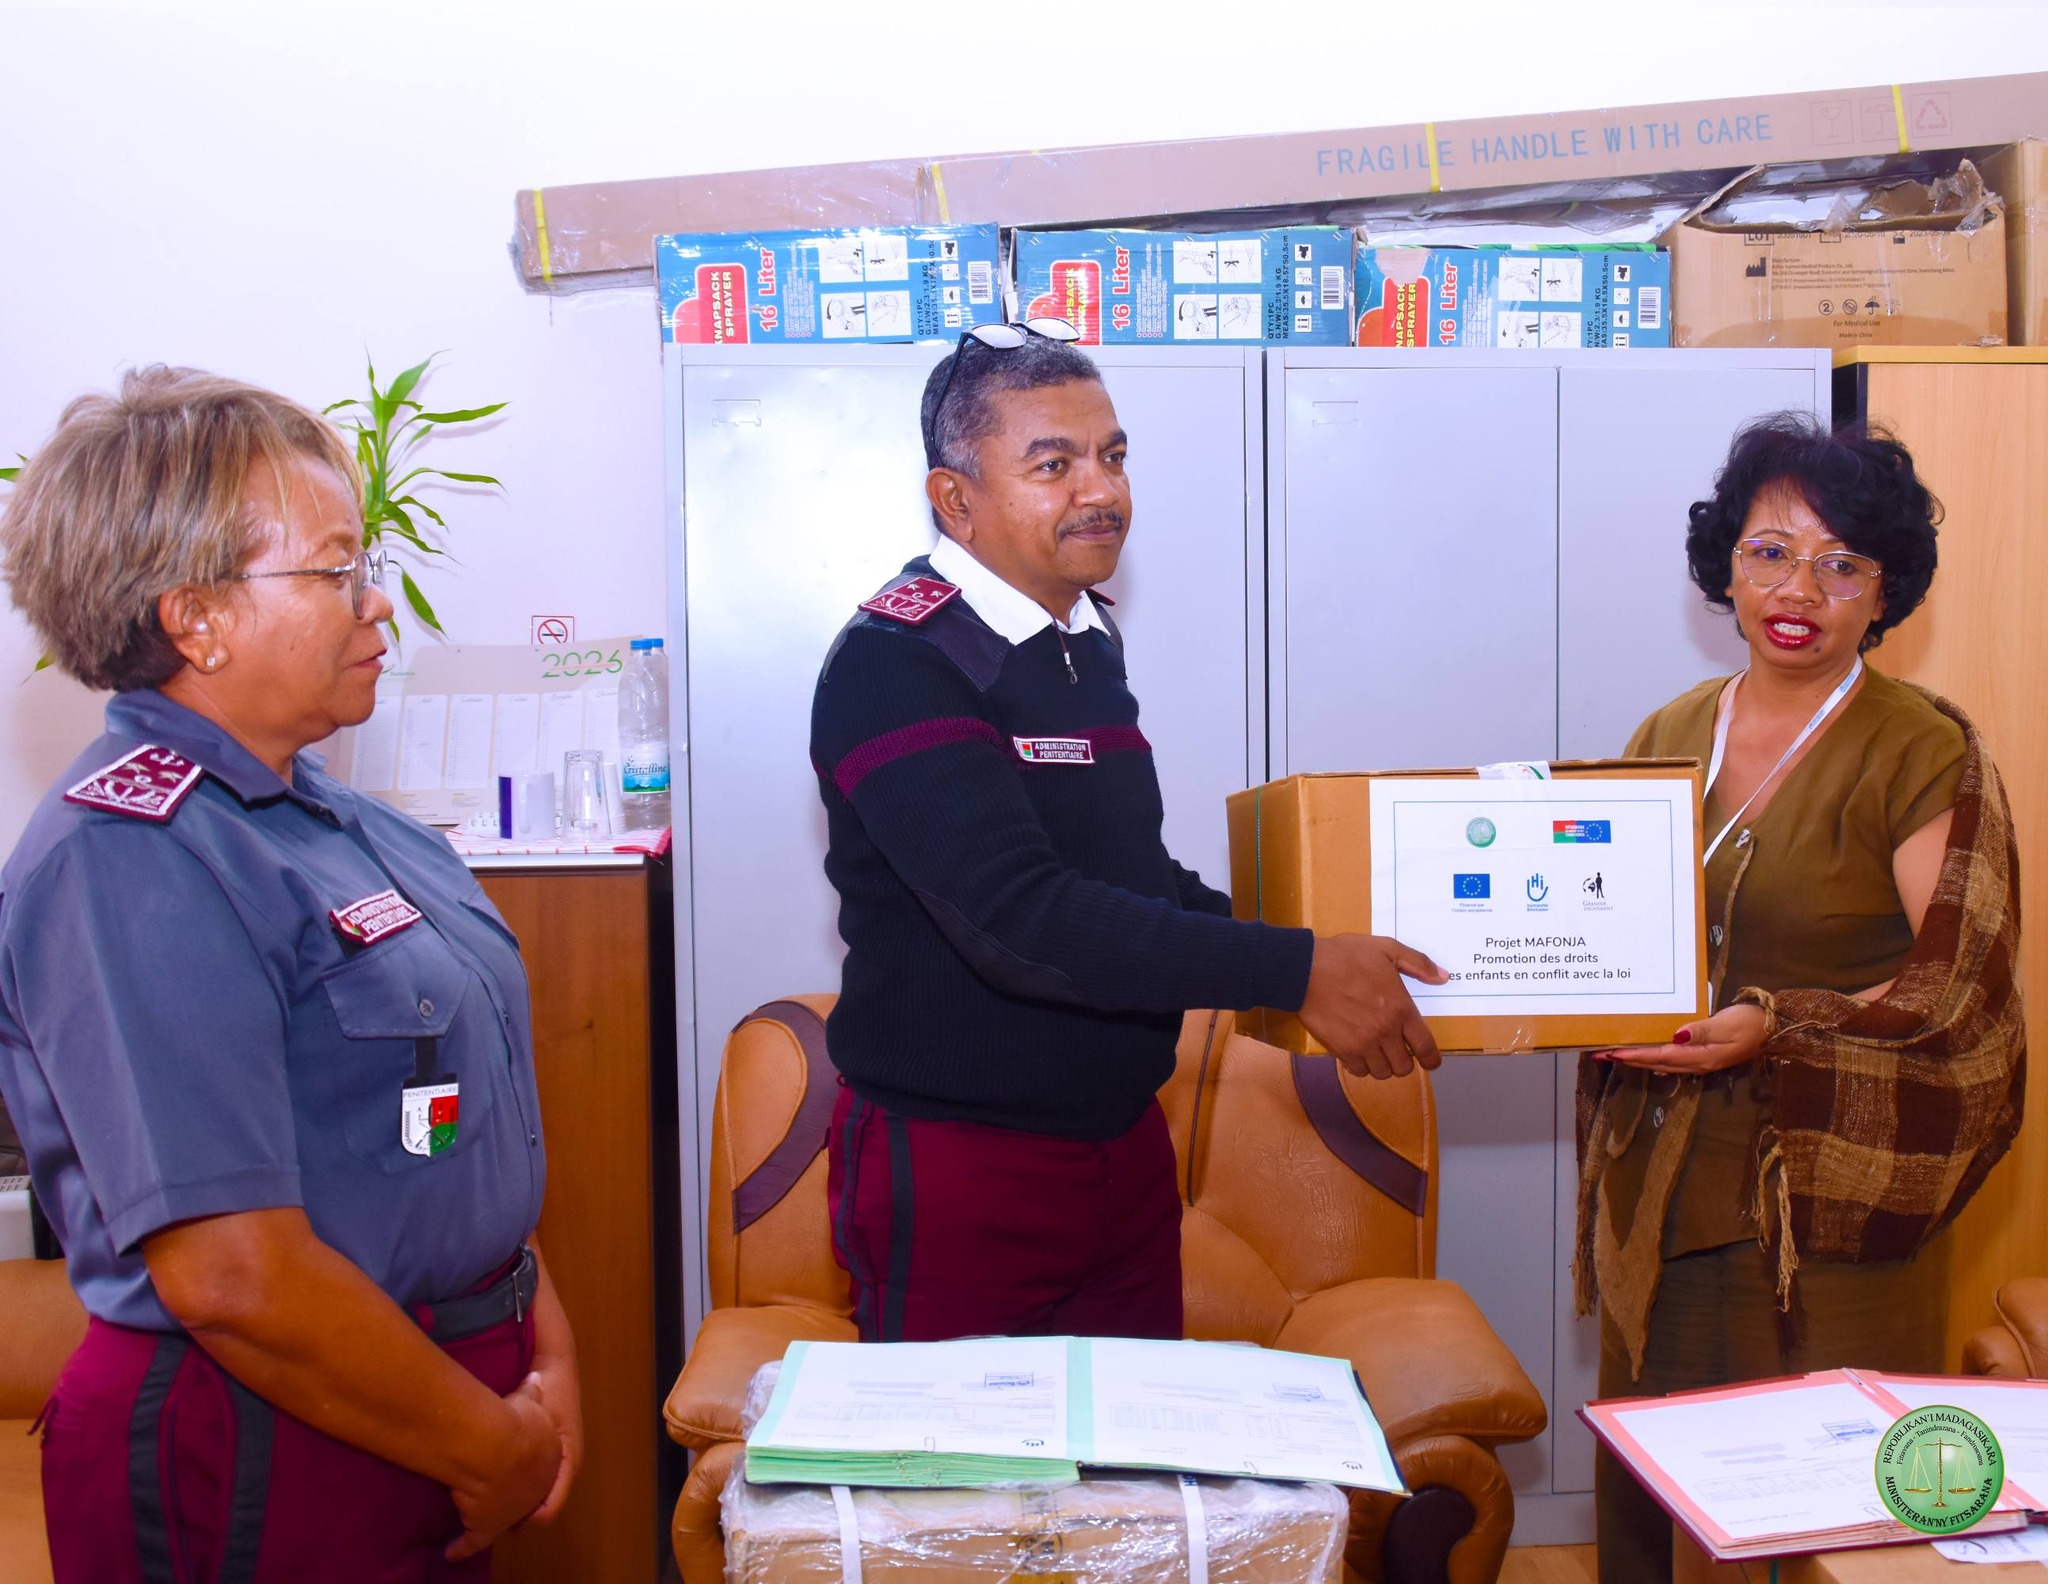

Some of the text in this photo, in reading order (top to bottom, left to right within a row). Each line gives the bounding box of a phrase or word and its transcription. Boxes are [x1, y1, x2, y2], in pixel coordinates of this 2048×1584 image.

[1317, 114, 1773, 176] FRAGILE HANDLE WITH CARE
[922, 265, 929, 278] KG
[1275, 268, 1281, 280] KG
[758, 247, 778, 332] 16 Liter
[1112, 246, 1131, 330] 16 Liter
[1594, 288, 1601, 300] KG
[722, 271, 735, 337] SPRAYER
[1440, 262, 1457, 345] 16 Liter
[916, 299, 924, 335] QTY:1PC
[1406, 283, 1417, 347] SPRAYER
[1034, 742, 1086, 751] ADMINISTRATION
[1039, 751, 1084, 759] PENITENTIAIRE
[1485, 937, 1586, 950] Projet MAFONJA
[1473, 953, 1598, 964] Promotion des droits
[1448, 972, 1462, 980] es
[1466, 970, 1510, 980] enfants
[1532, 969, 1570, 979] conflit
[1573, 971, 1600, 979] avec
[1603, 968, 1613, 979] la
[1617, 968, 1631, 978] loi
[403, 1086, 456, 1098] PENITENTIAIRE
